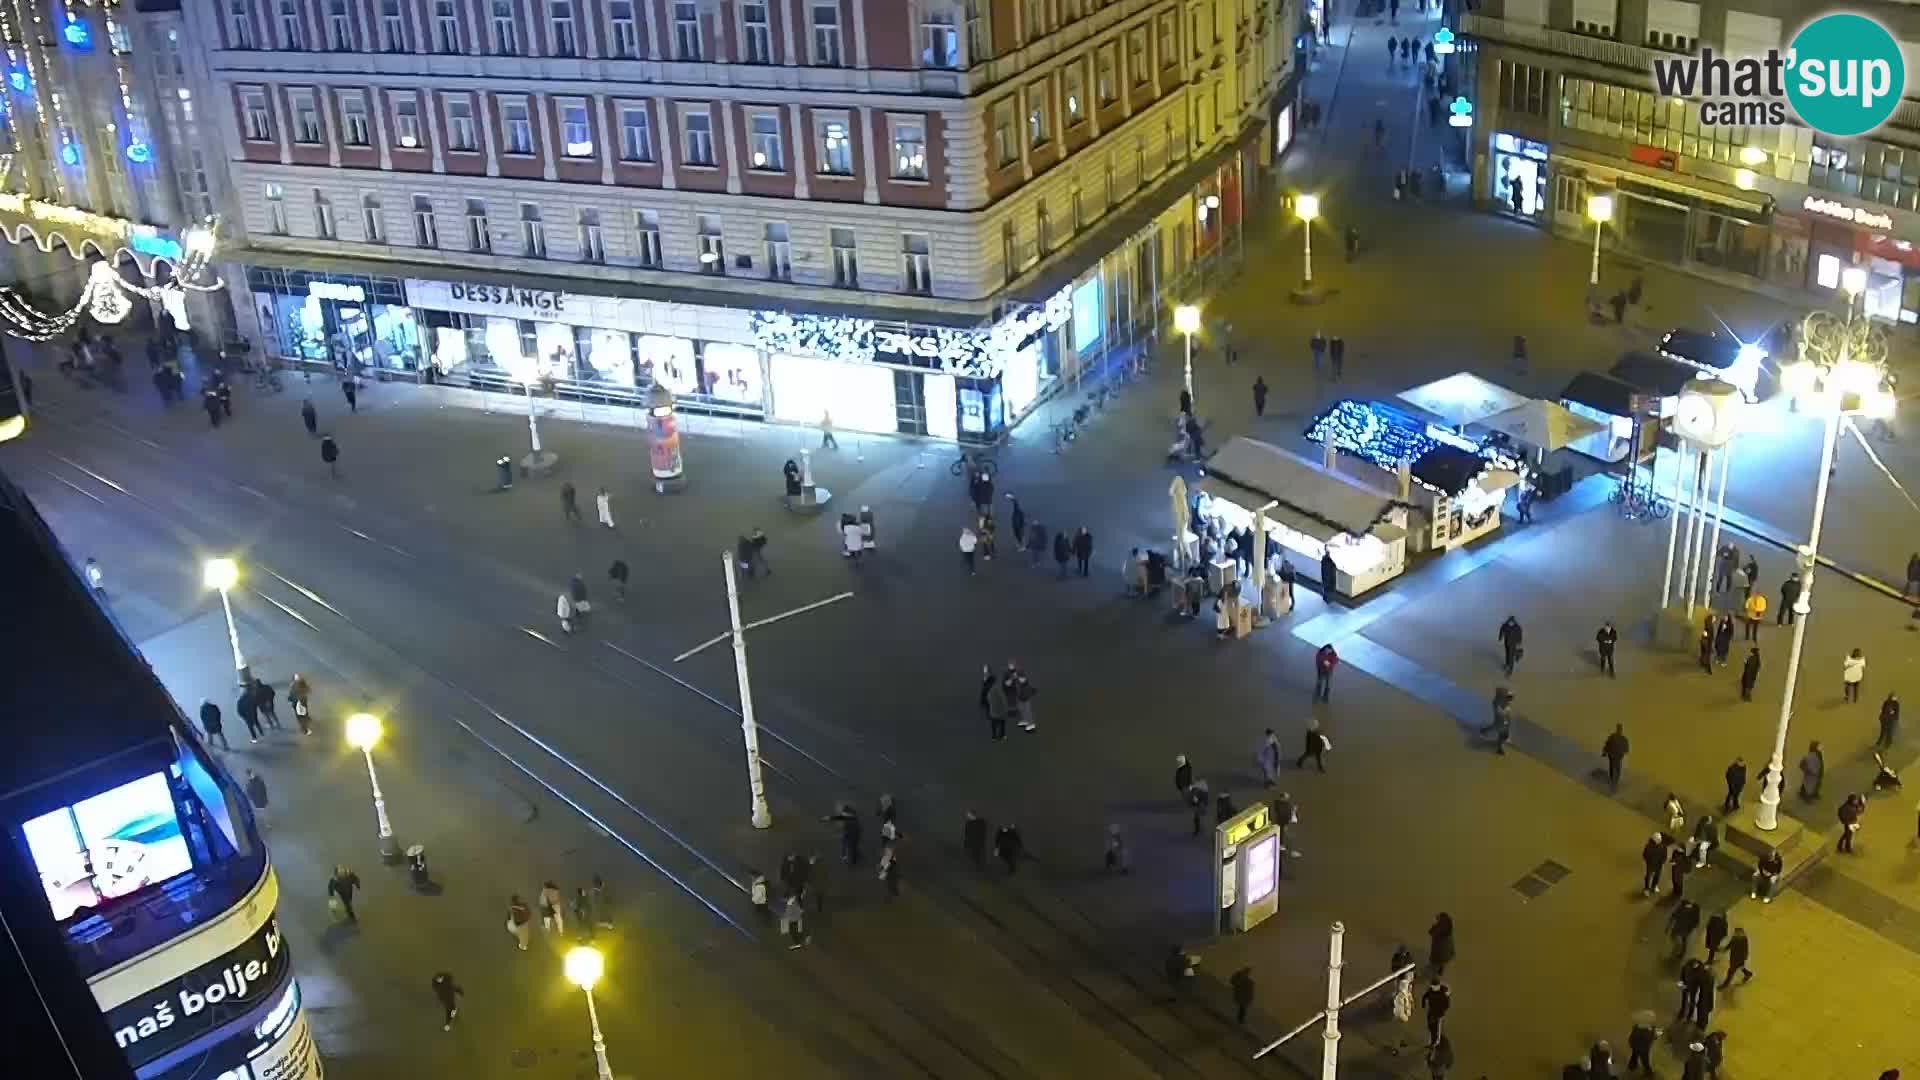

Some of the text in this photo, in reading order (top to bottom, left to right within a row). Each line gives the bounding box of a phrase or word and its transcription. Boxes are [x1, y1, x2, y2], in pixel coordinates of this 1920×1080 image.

[450, 283, 565, 311] DESSANGE
[114, 1000, 176, 1049] naš
[178, 958, 268, 1017] bolje,
